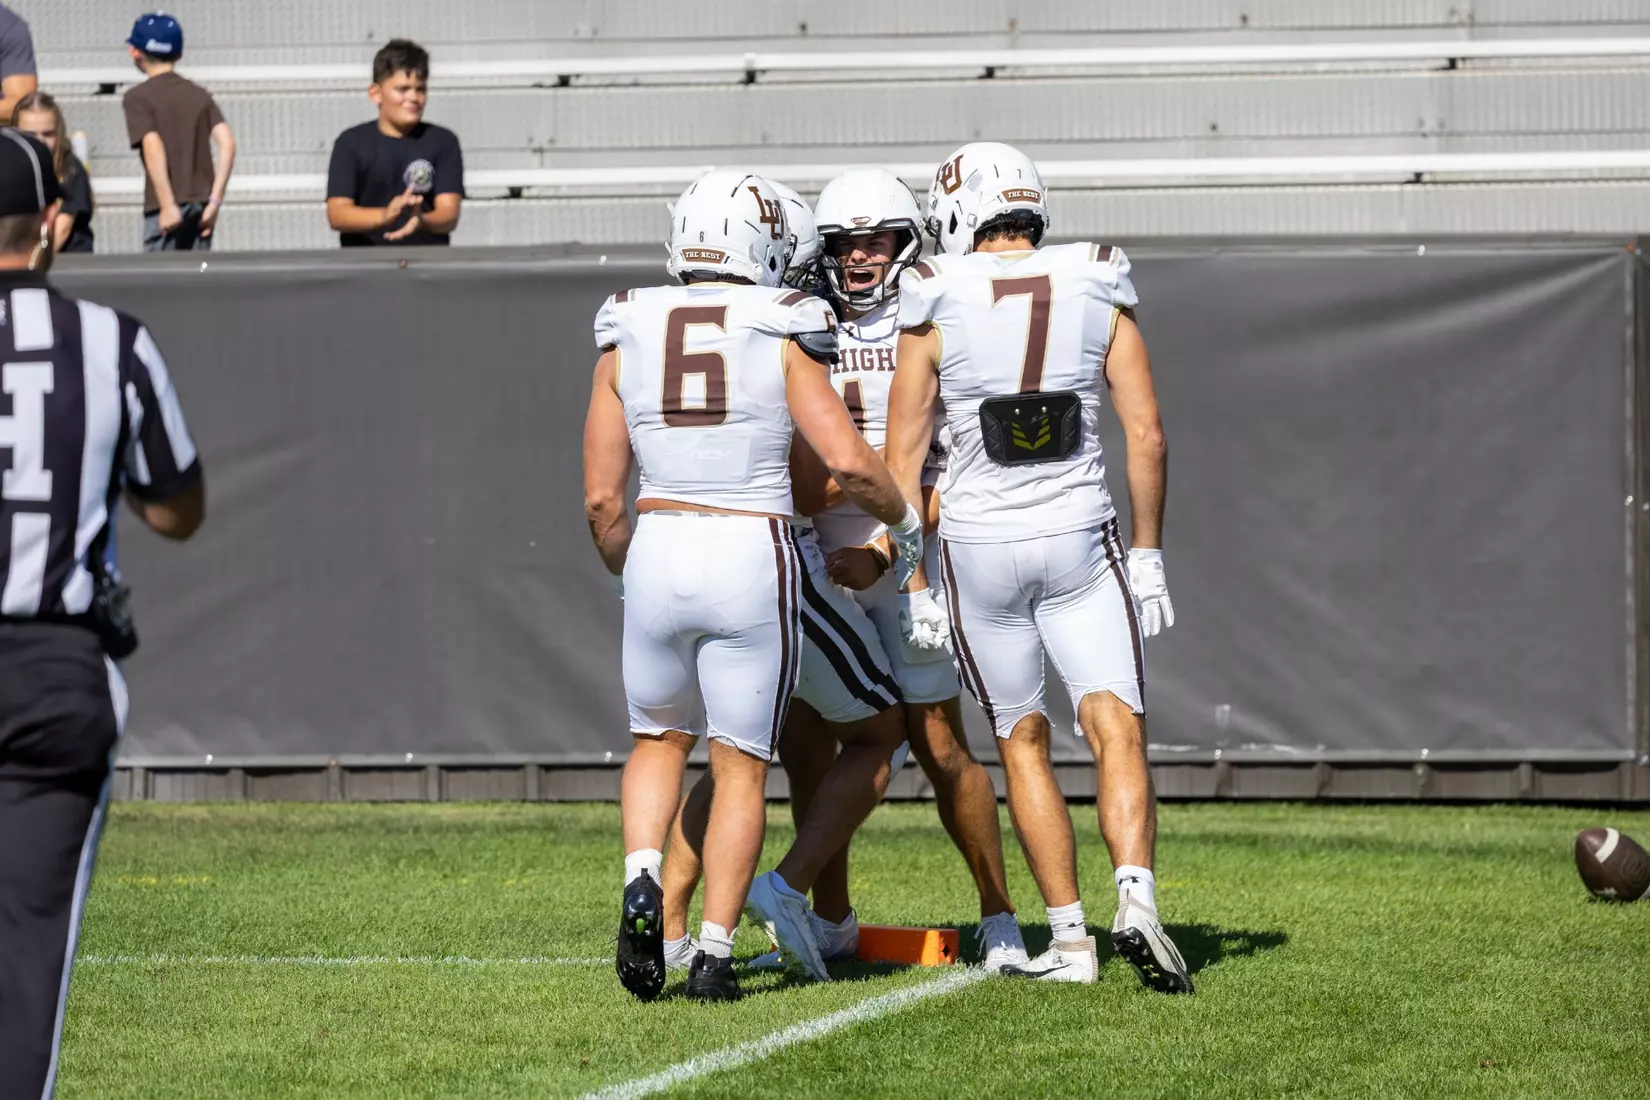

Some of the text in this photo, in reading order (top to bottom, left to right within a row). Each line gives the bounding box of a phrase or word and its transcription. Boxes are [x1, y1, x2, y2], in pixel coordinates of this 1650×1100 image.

[1007, 190, 1022, 199] THE
[699, 230, 705, 243] 6
[685, 251, 699, 259] THE
[988, 273, 1054, 393] 7
[661, 303, 730, 428] 6
